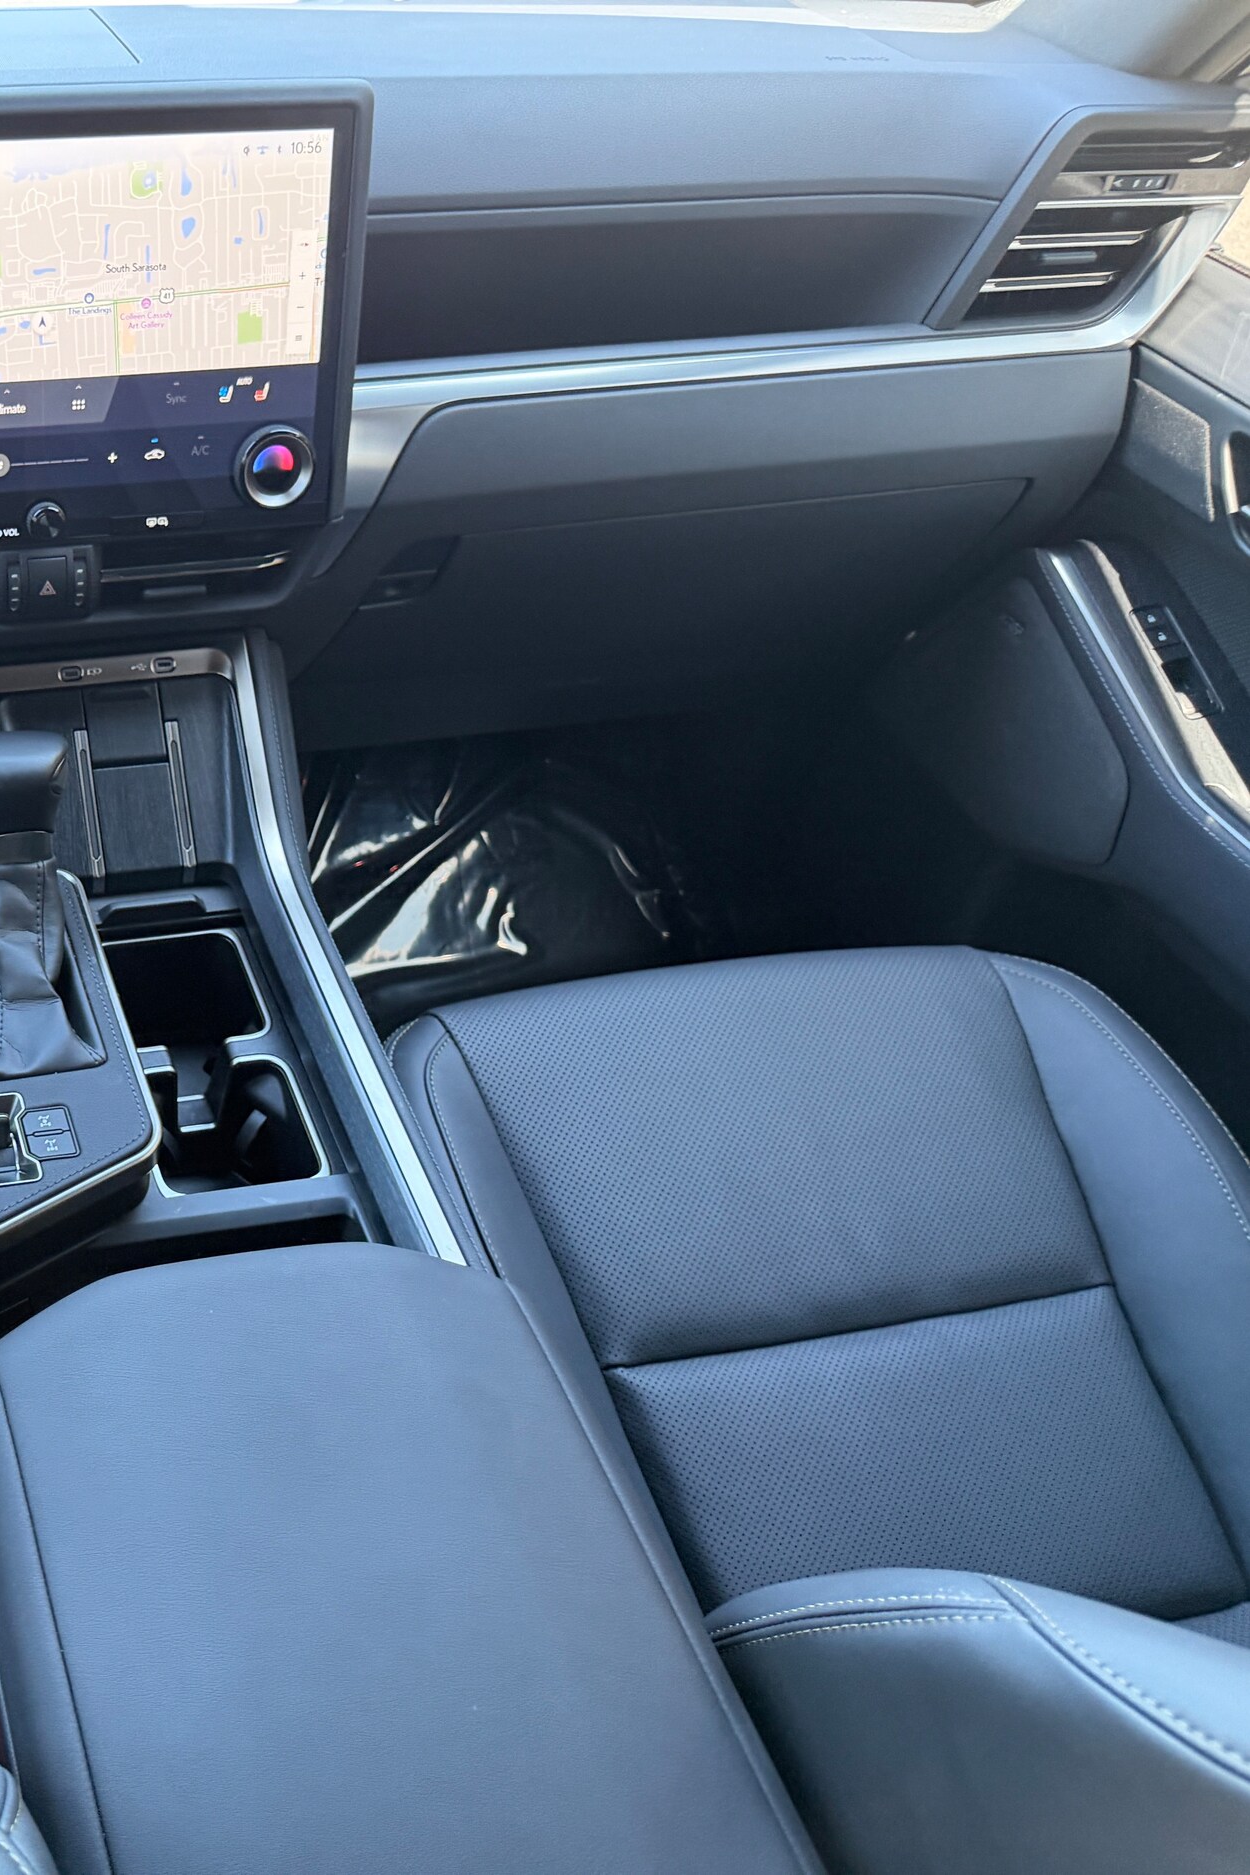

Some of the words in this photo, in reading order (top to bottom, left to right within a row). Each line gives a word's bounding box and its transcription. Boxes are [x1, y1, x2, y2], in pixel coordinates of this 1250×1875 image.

[291, 141, 322, 154] 10:56
[106, 264, 130, 273] South
[132, 262, 167, 272] Sarasota
[163, 292, 171, 300] 41
[68, 307, 82, 316] The
[83, 306, 113, 317] Landings
[120, 312, 146, 321] Colleen
[147, 310, 173, 321] Cassidy
[128, 321, 140, 329] Art
[141, 320, 165, 331] Gallery
[166, 393, 187, 404] Sync
[191, 445, 210, 456] A/C
[3, 528, 20, 537] VOL
